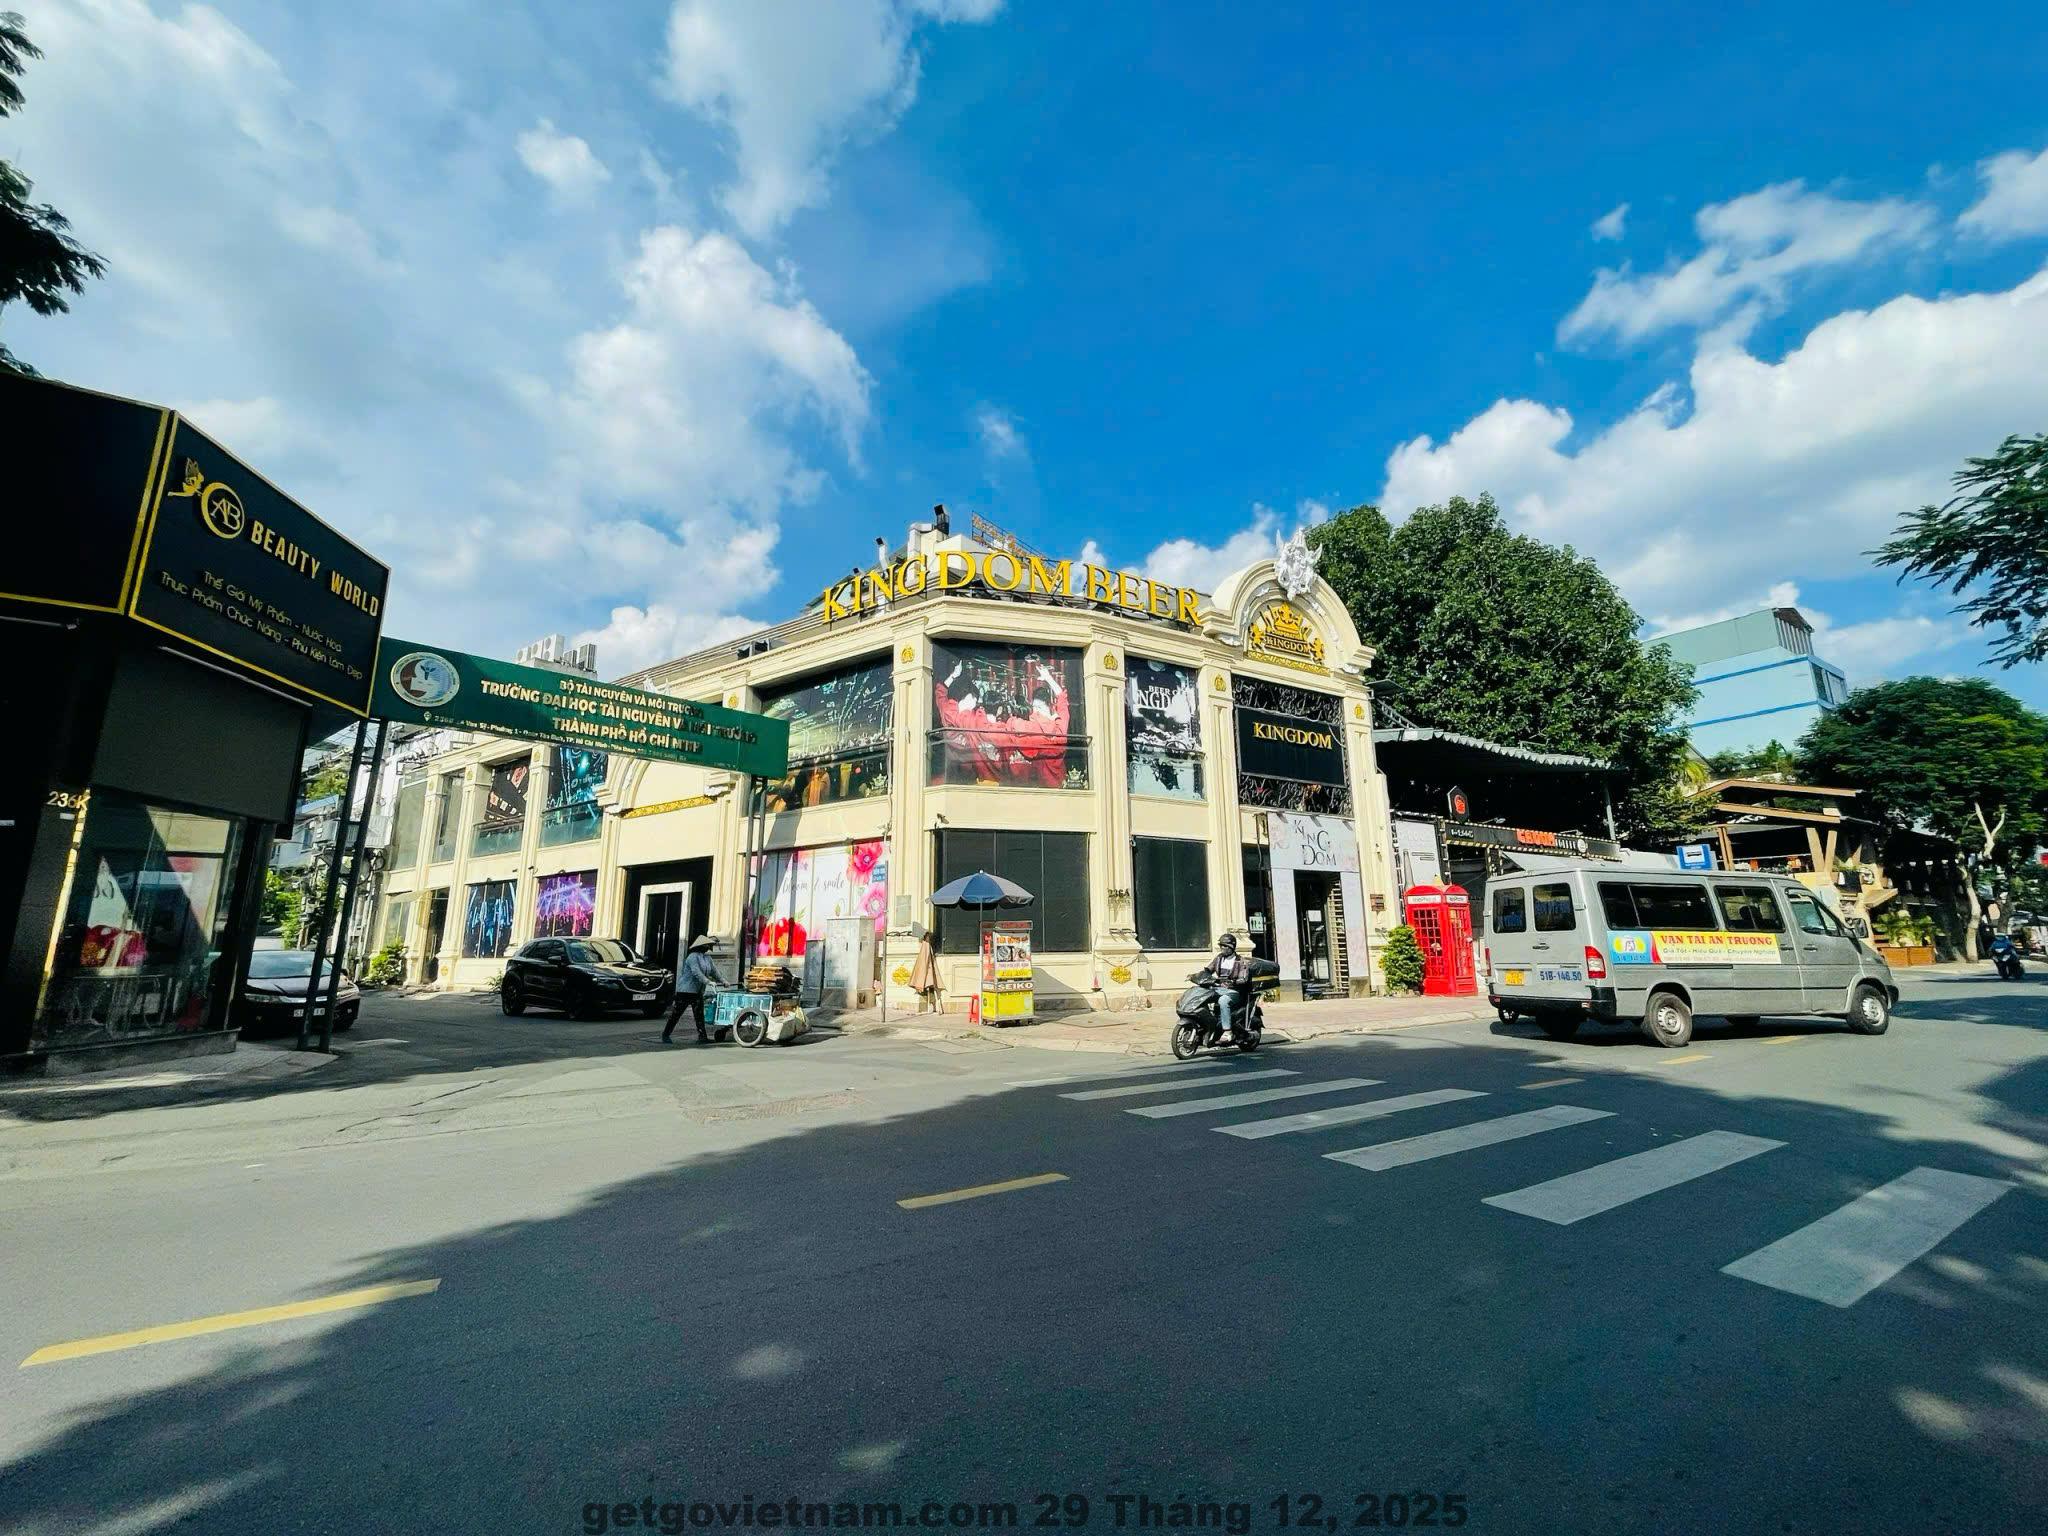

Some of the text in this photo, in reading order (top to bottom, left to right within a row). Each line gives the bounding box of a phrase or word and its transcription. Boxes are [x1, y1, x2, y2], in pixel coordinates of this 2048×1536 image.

[251, 519, 379, 617] BEAUTY WORLD
[822, 549, 1202, 626] KINGDOM BEER
[481, 679, 540, 703] TRƯỜNG
[542, 692, 566, 710] ĐẠI
[568, 698, 598, 716] HỌC
[600, 701, 620, 719] TÀI
[621, 706, 671, 729] NGUYÊN
[559, 680, 575, 694] BỘ
[576, 682, 592, 695] TÀI
[593, 685, 633, 703] NGUYÊN
[634, 693, 647, 706] VÀ
[647, 697, 666, 709] MÔI
[552, 717, 599, 736] THÀNH
[628, 726, 647, 744] HỒ
[649, 732, 670, 748] CHÍ
[1252, 721, 1333, 750] KINGDOM
[997, 982, 1034, 991] SEIKO
